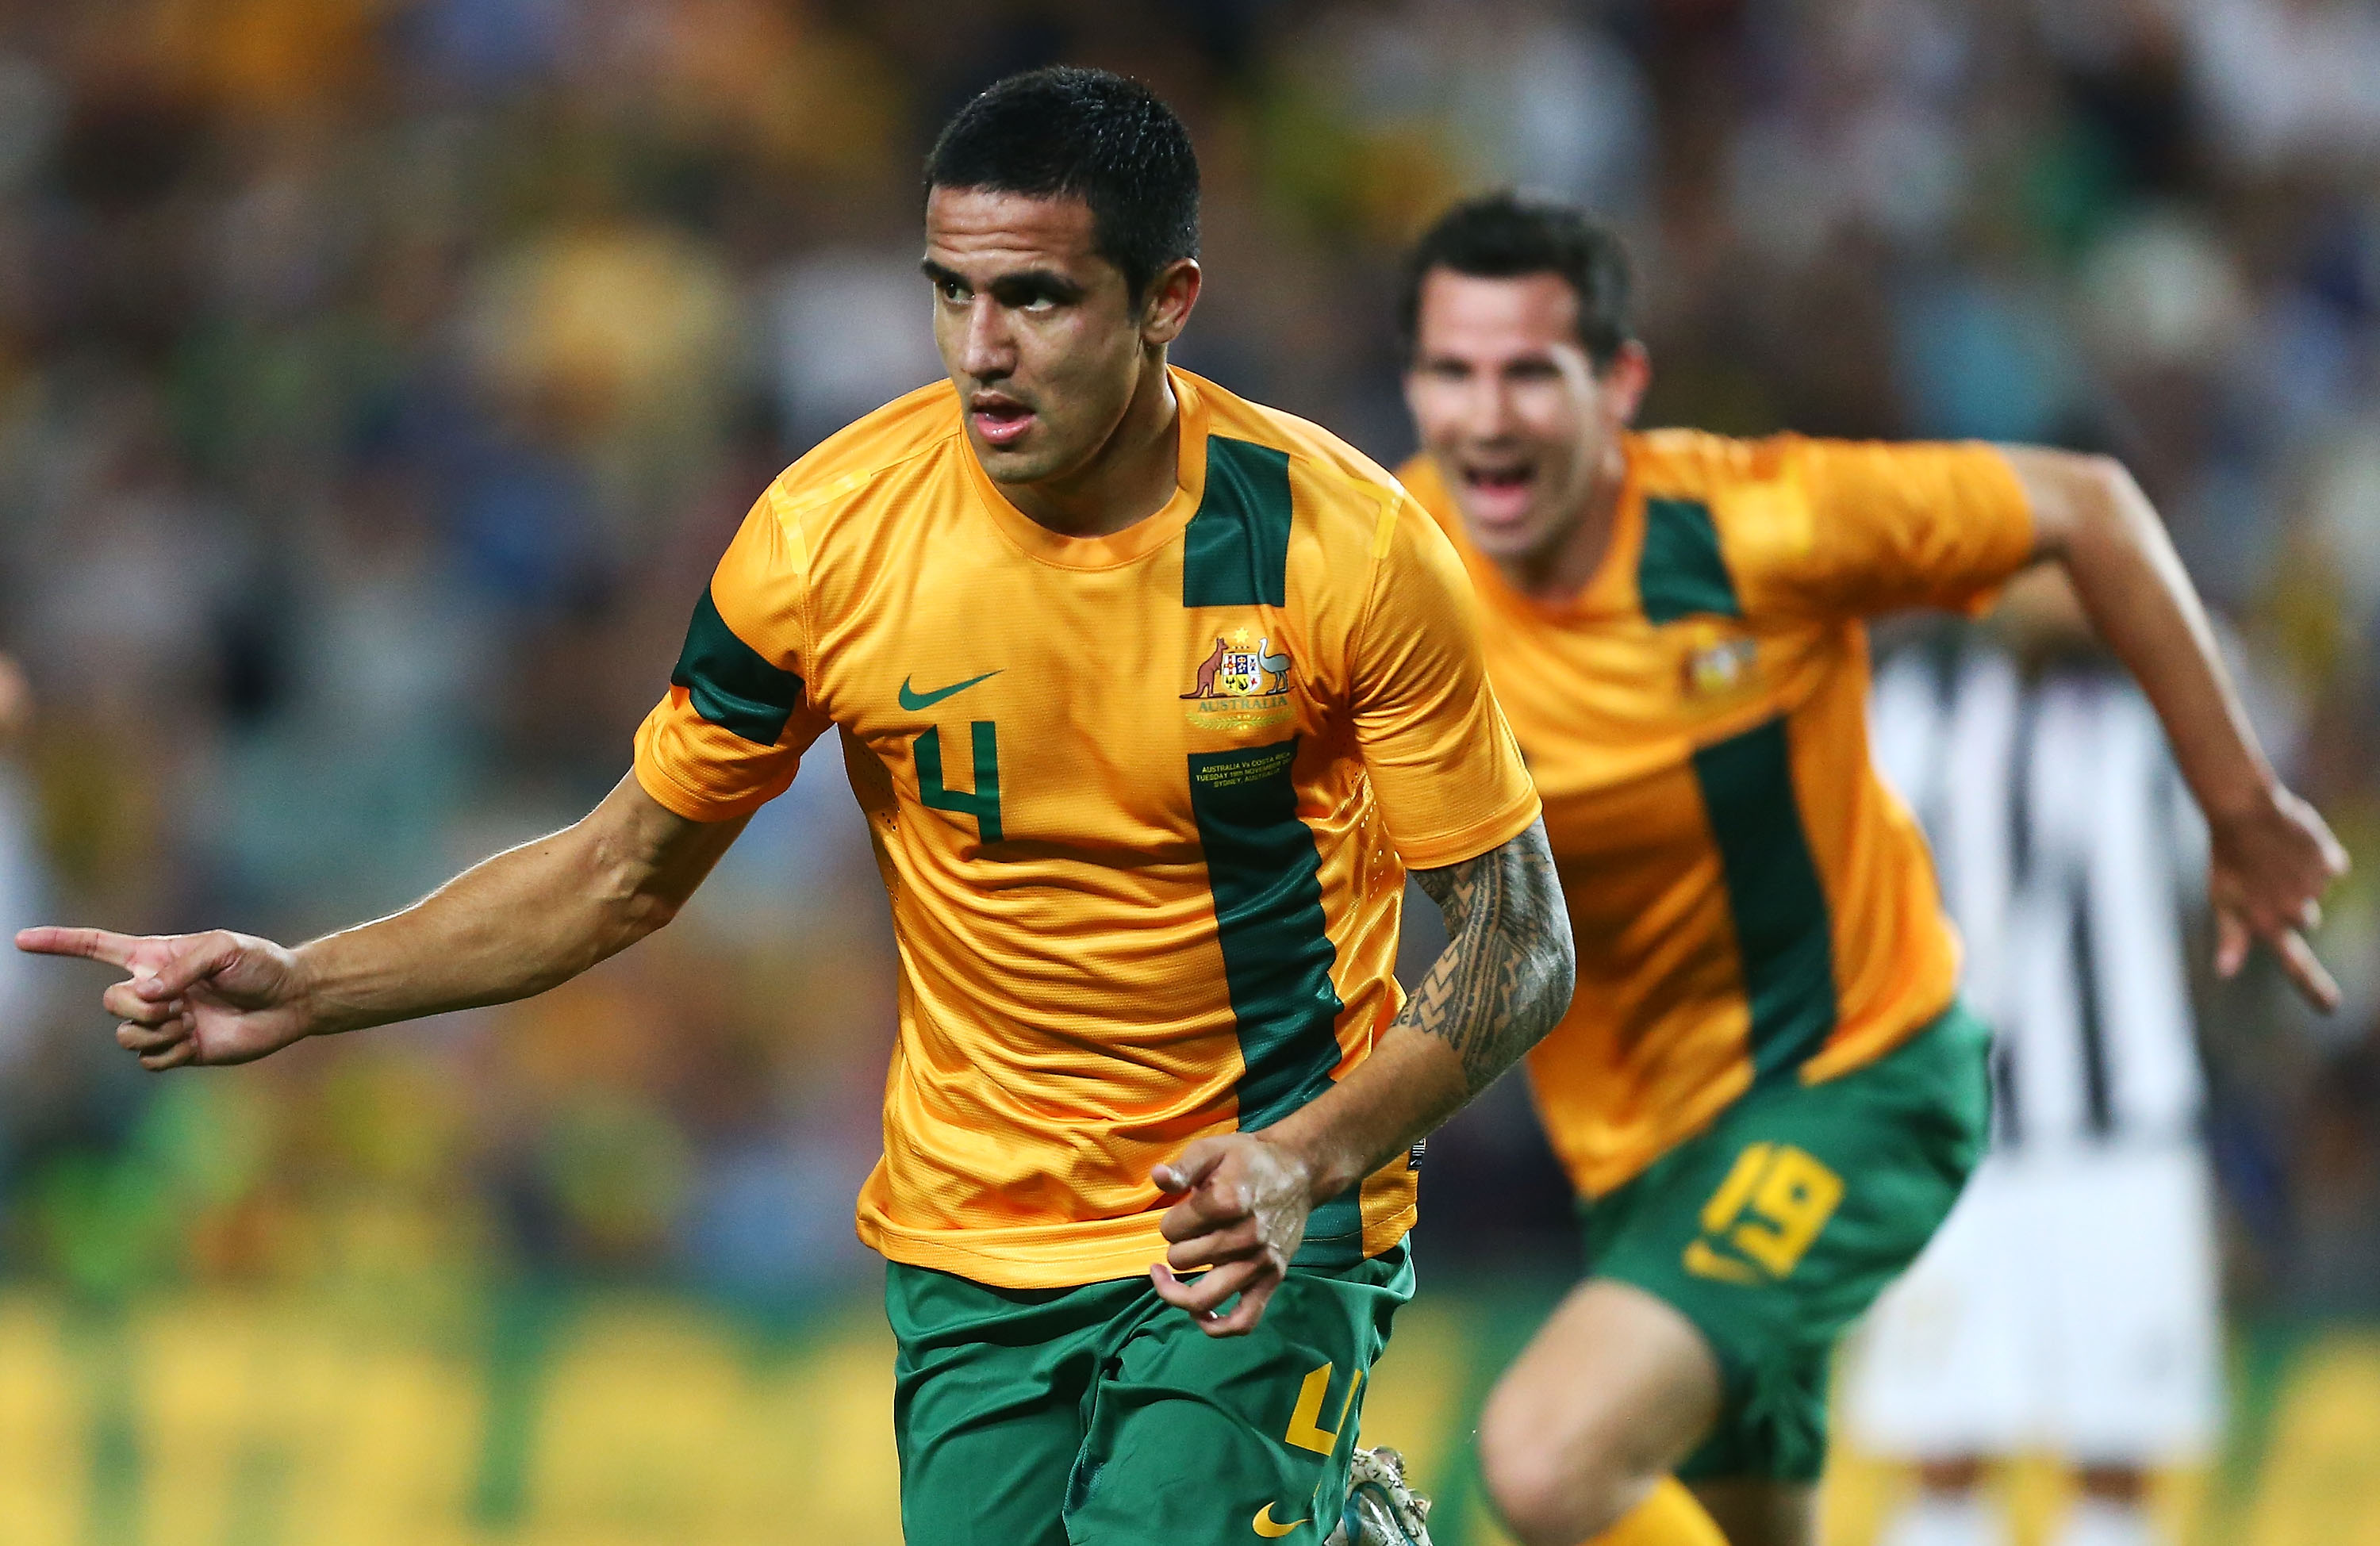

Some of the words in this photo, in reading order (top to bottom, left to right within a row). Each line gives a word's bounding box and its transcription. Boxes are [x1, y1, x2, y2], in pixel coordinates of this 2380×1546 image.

[1198, 695, 1288, 712] AUSTRALIA
[1202, 762, 1240, 773] AUSTRALIA
[1251, 756, 1275, 768] COSTA
[913, 721, 1005, 845] 4
[1196, 773, 1229, 781] TUESDAY
[1699, 1141, 1844, 1279] 19
